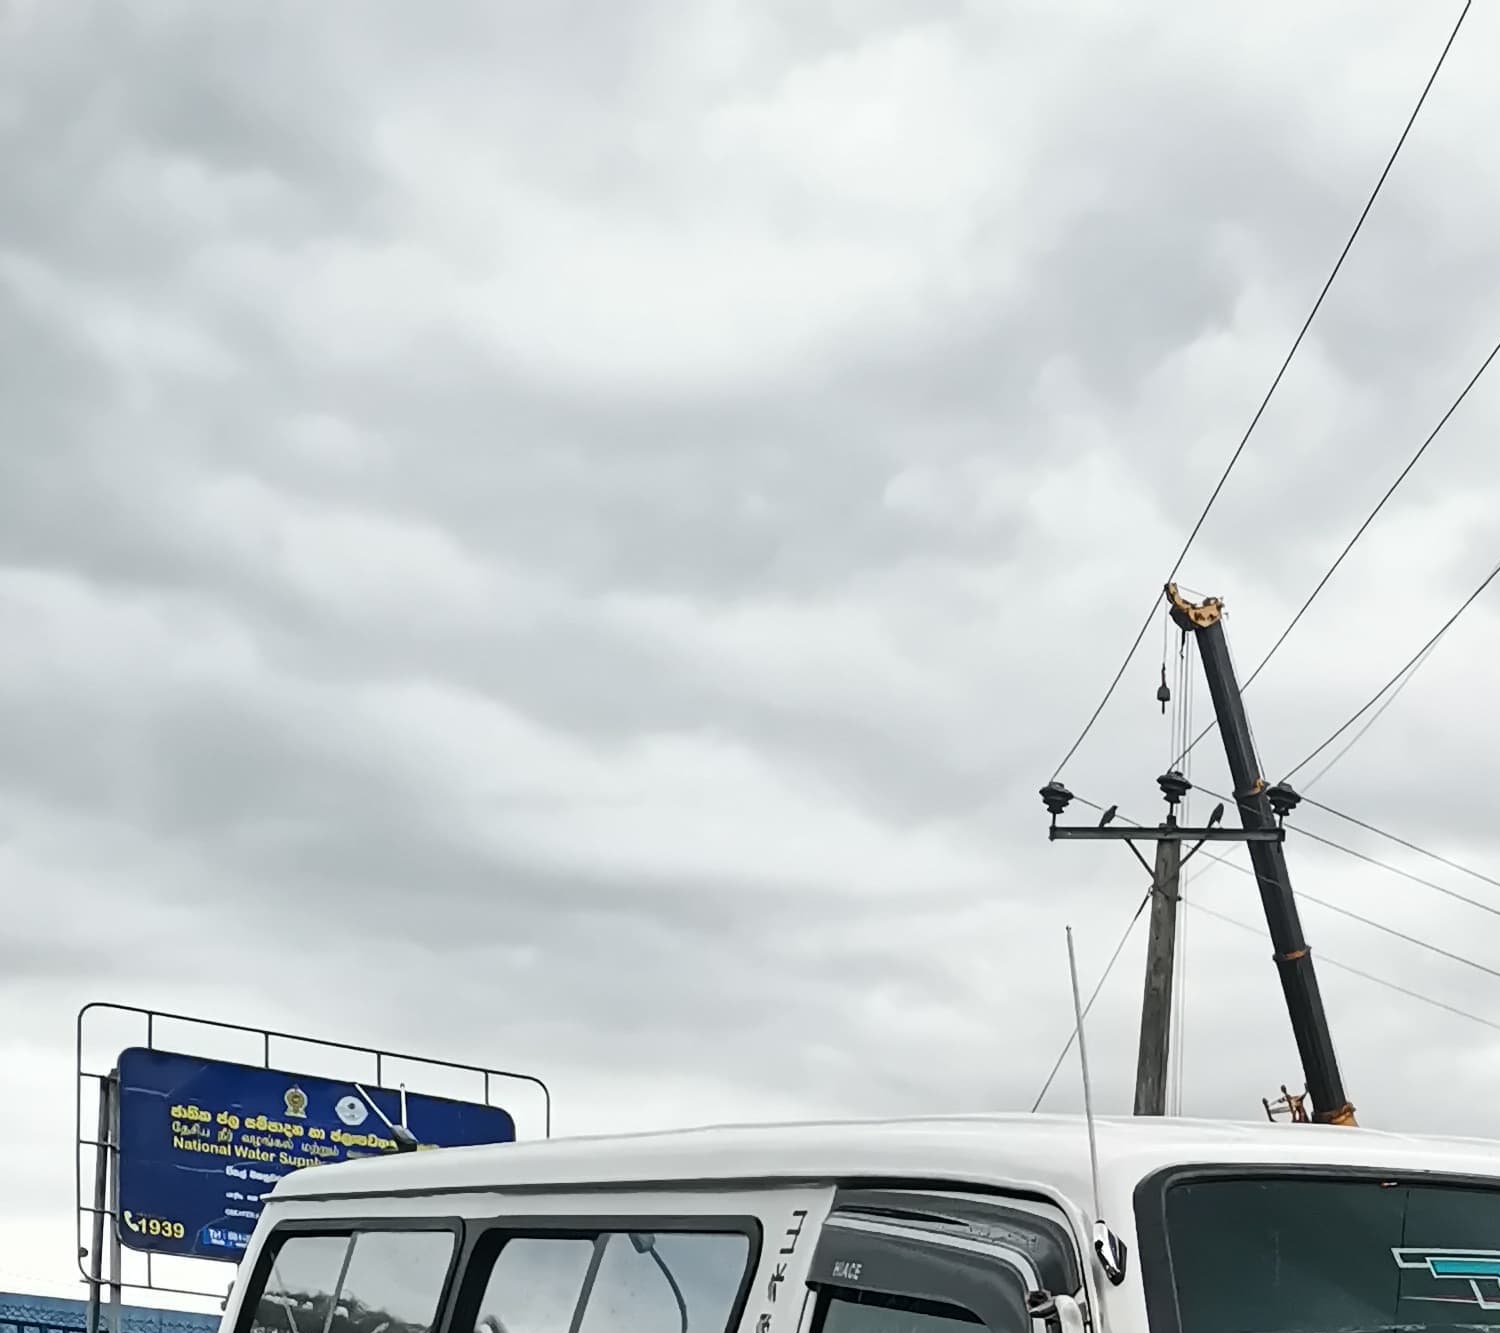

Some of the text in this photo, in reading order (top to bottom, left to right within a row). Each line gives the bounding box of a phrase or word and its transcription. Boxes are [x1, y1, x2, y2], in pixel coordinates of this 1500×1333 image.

[173, 1135, 232, 1156] National
[234, 1145, 277, 1162] Water
[138, 1218, 185, 1238] 1939
